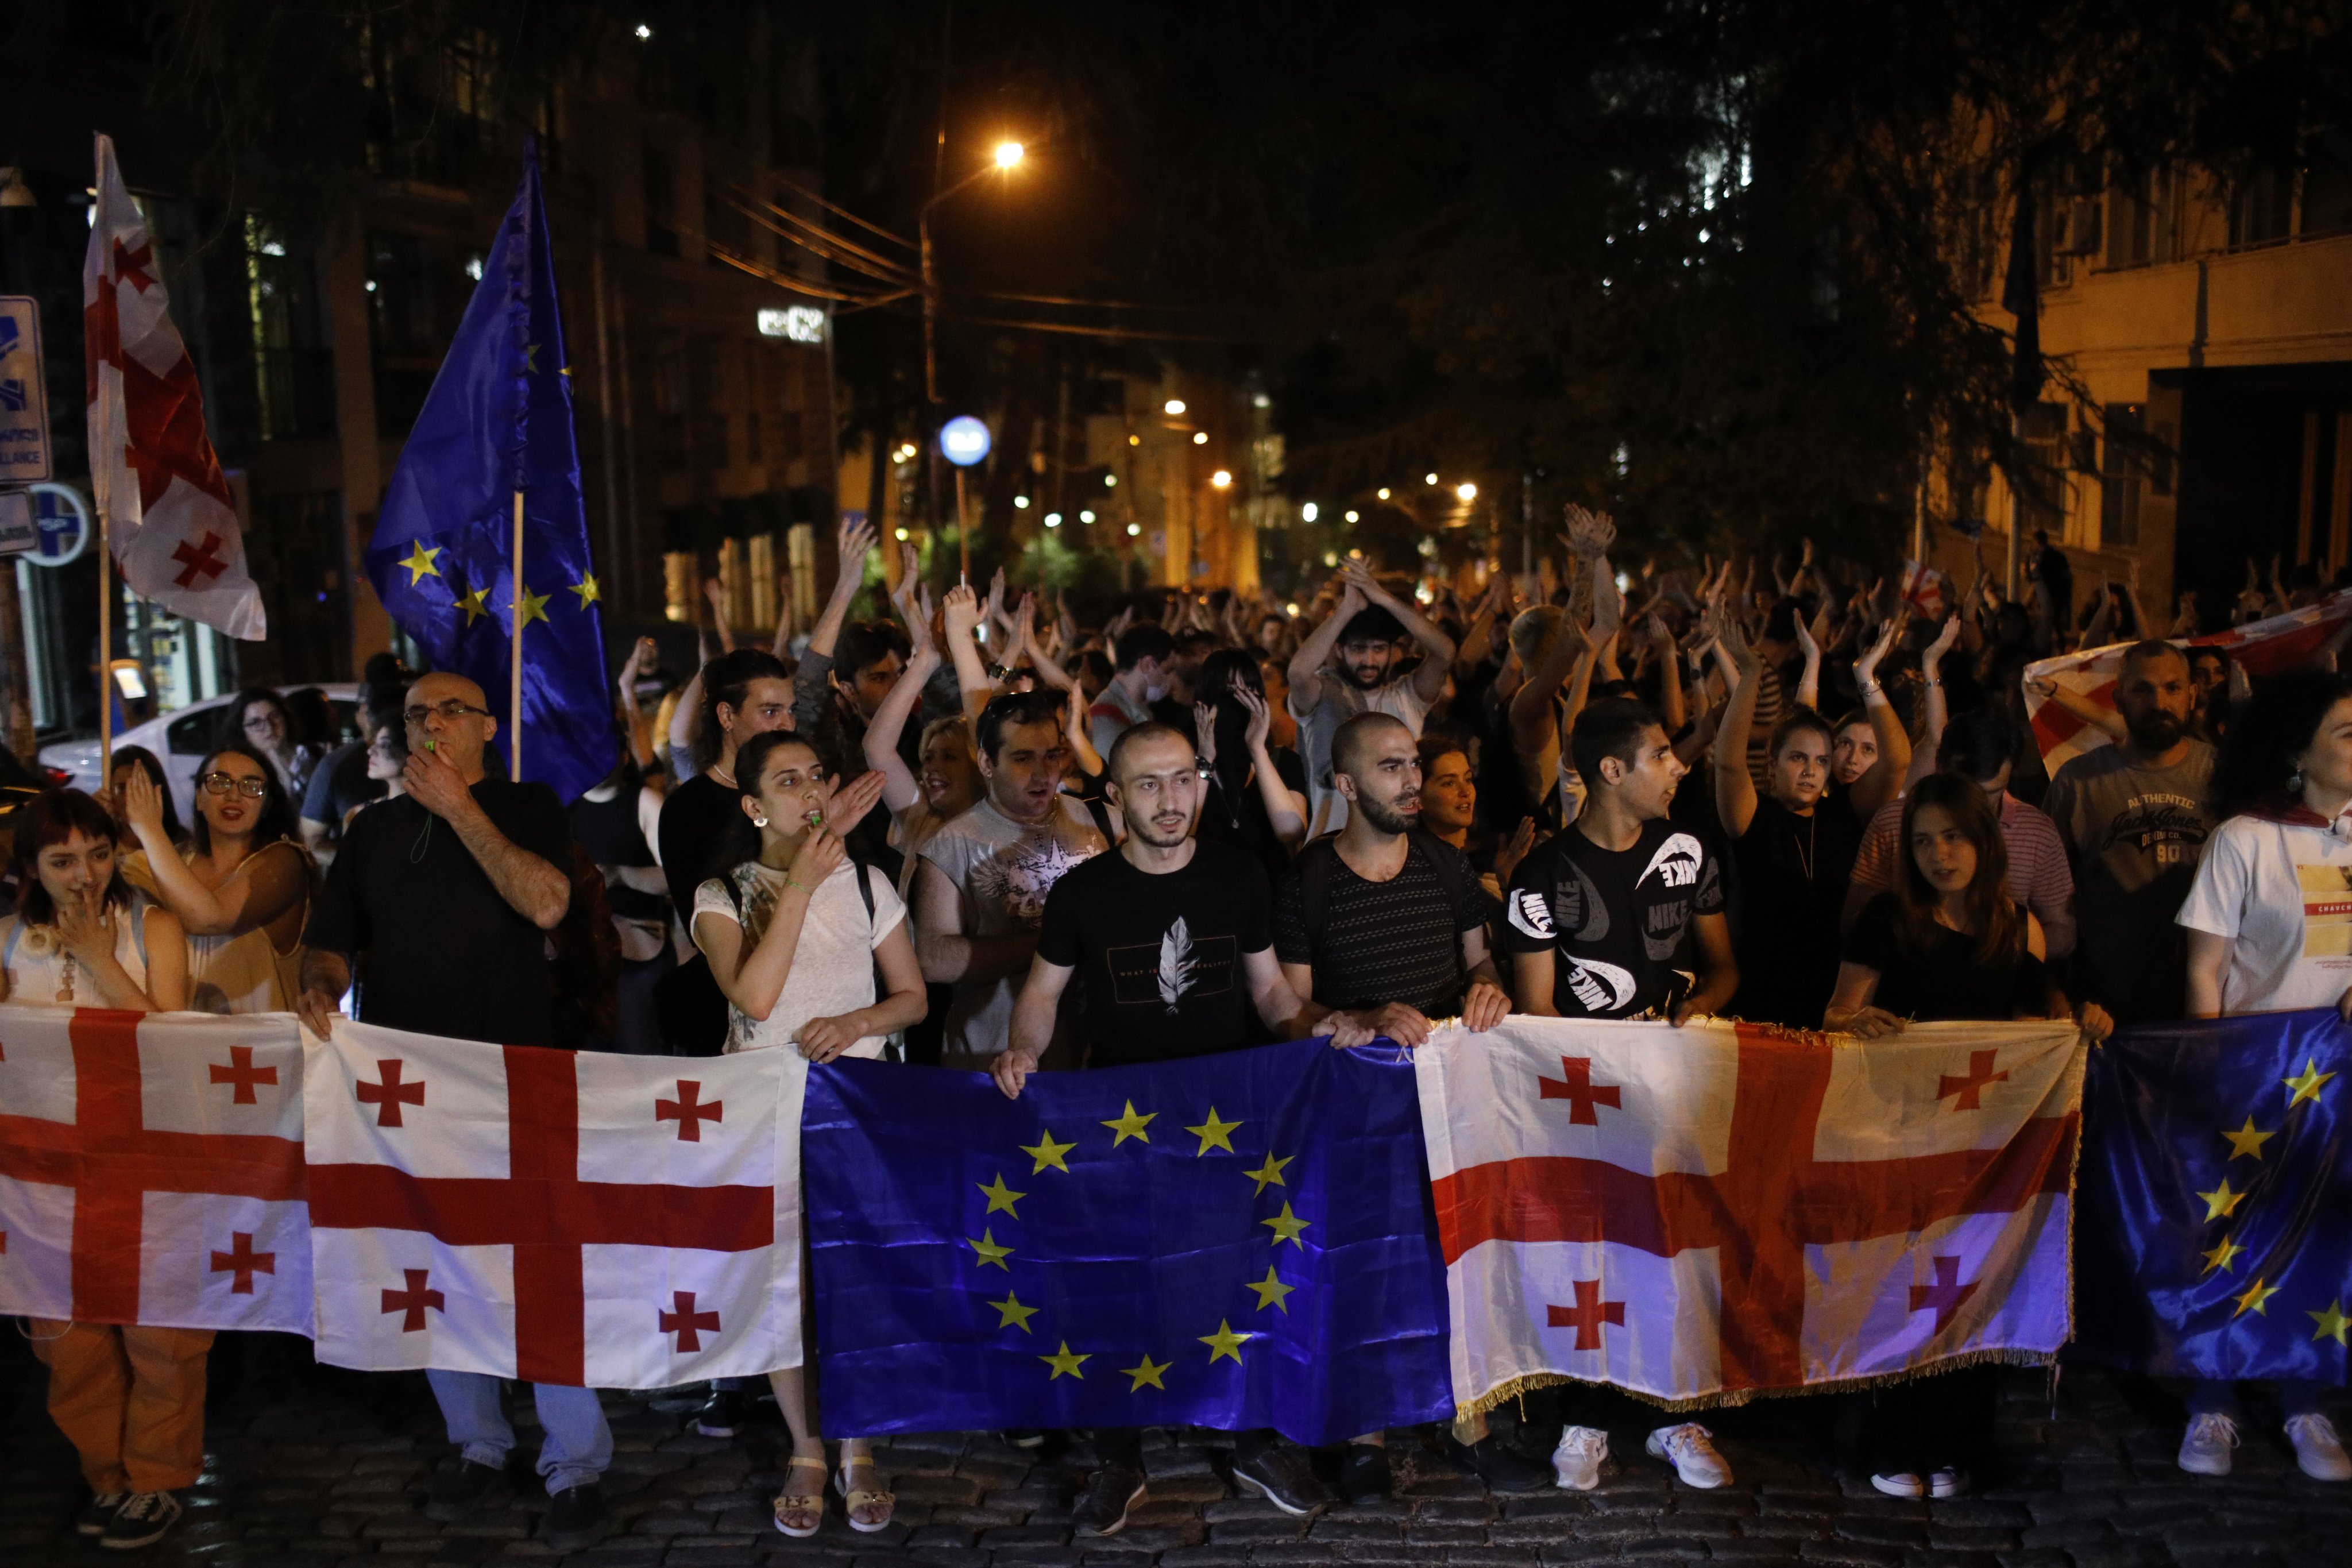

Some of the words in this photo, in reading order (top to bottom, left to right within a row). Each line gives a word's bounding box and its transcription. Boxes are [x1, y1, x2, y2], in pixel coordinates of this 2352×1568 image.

[2127, 793, 2196, 809] AUTHENTIC
[2157, 844, 2181, 863] 90
[1658, 860, 1697, 887] NIKE
[1554, 880, 1581, 929] NIKE
[1648, 899, 1688, 933] NIKE
[1566, 965, 1613, 1012] NIKE
